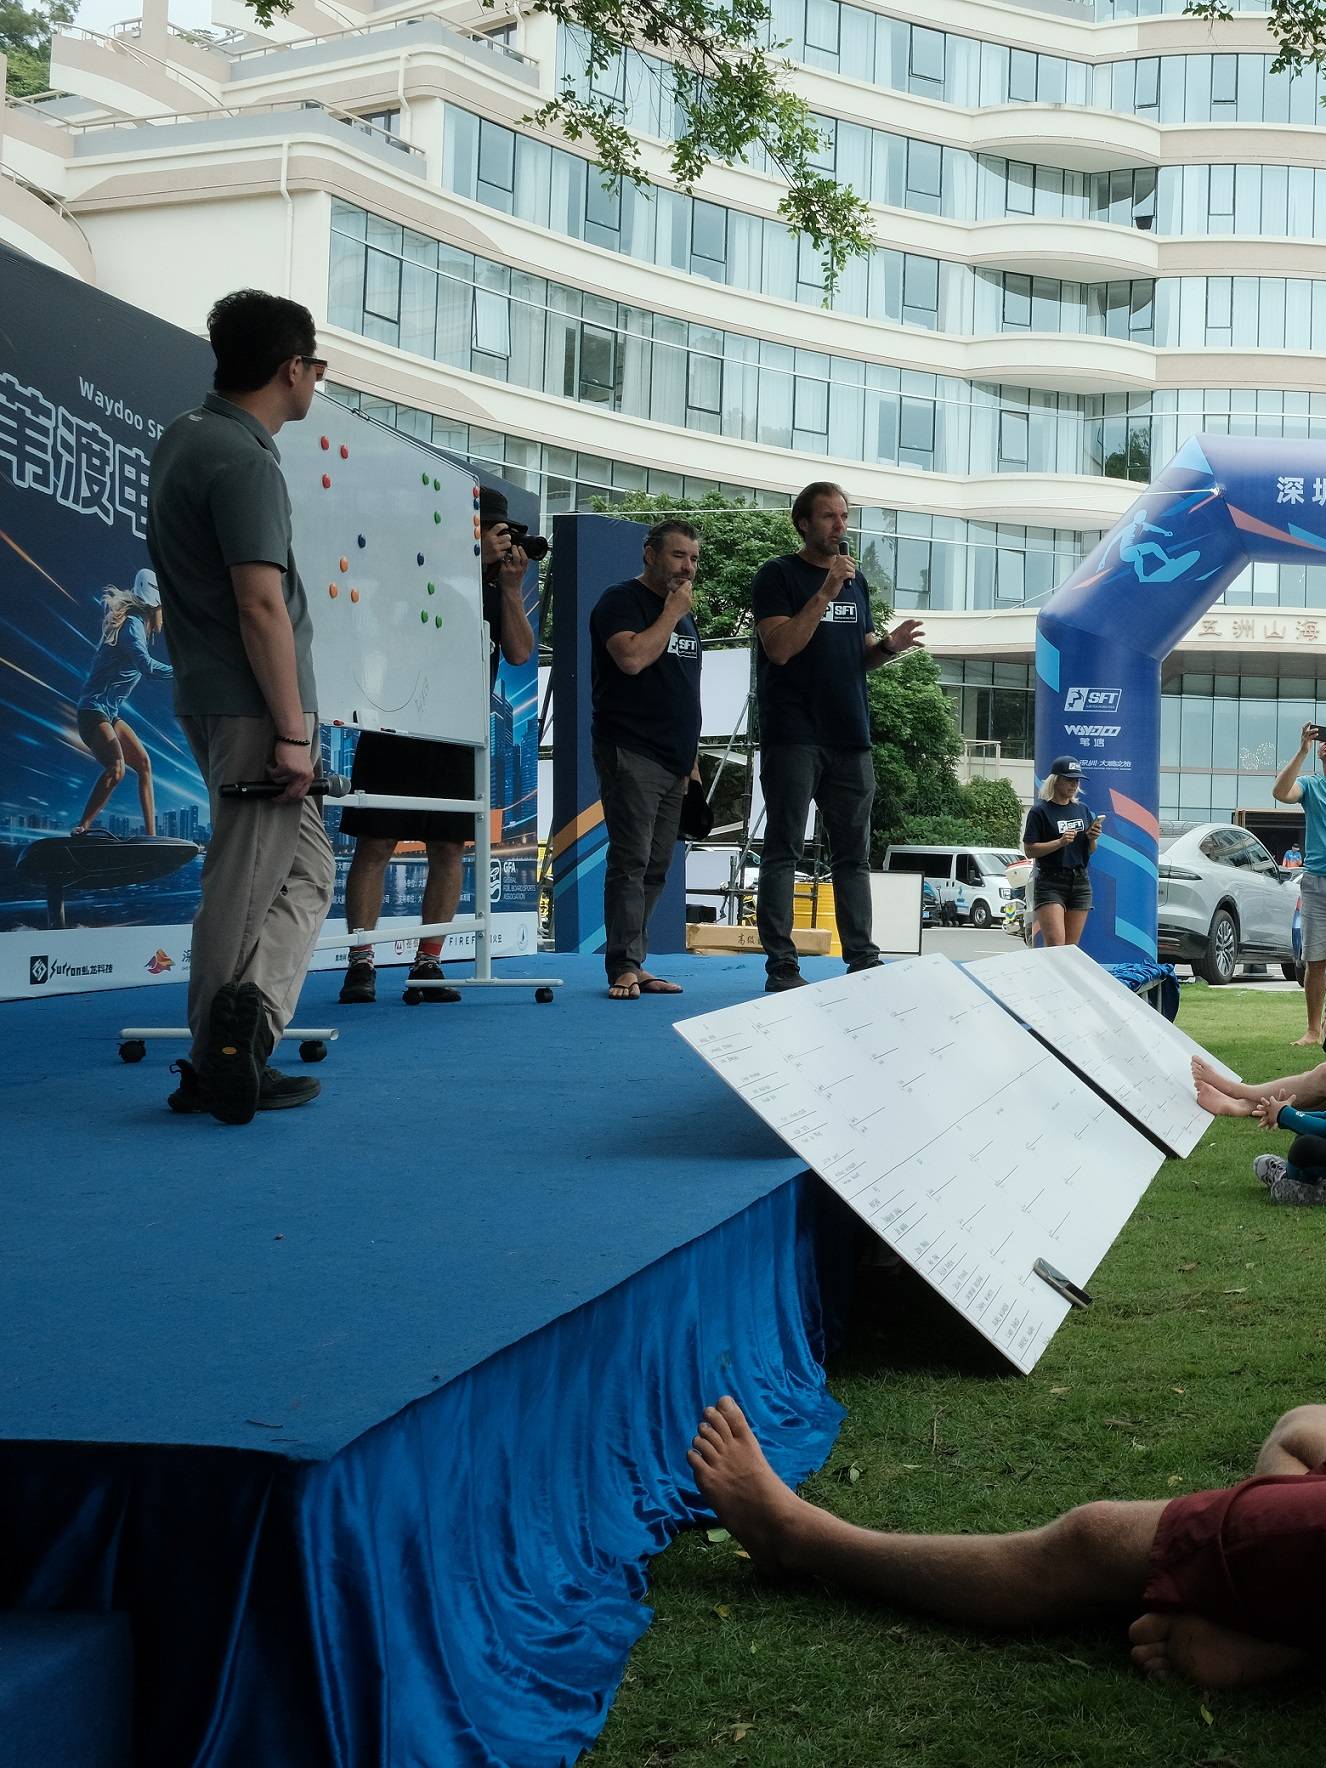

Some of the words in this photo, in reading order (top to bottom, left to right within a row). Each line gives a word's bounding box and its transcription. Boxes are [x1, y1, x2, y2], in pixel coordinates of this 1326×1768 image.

[79, 376, 143, 430] Waydoo
[147, 418, 165, 441] SF
[834, 605, 855, 616] SFT
[678, 638, 696, 650] SFT
[1087, 692, 1119, 704] SFT
